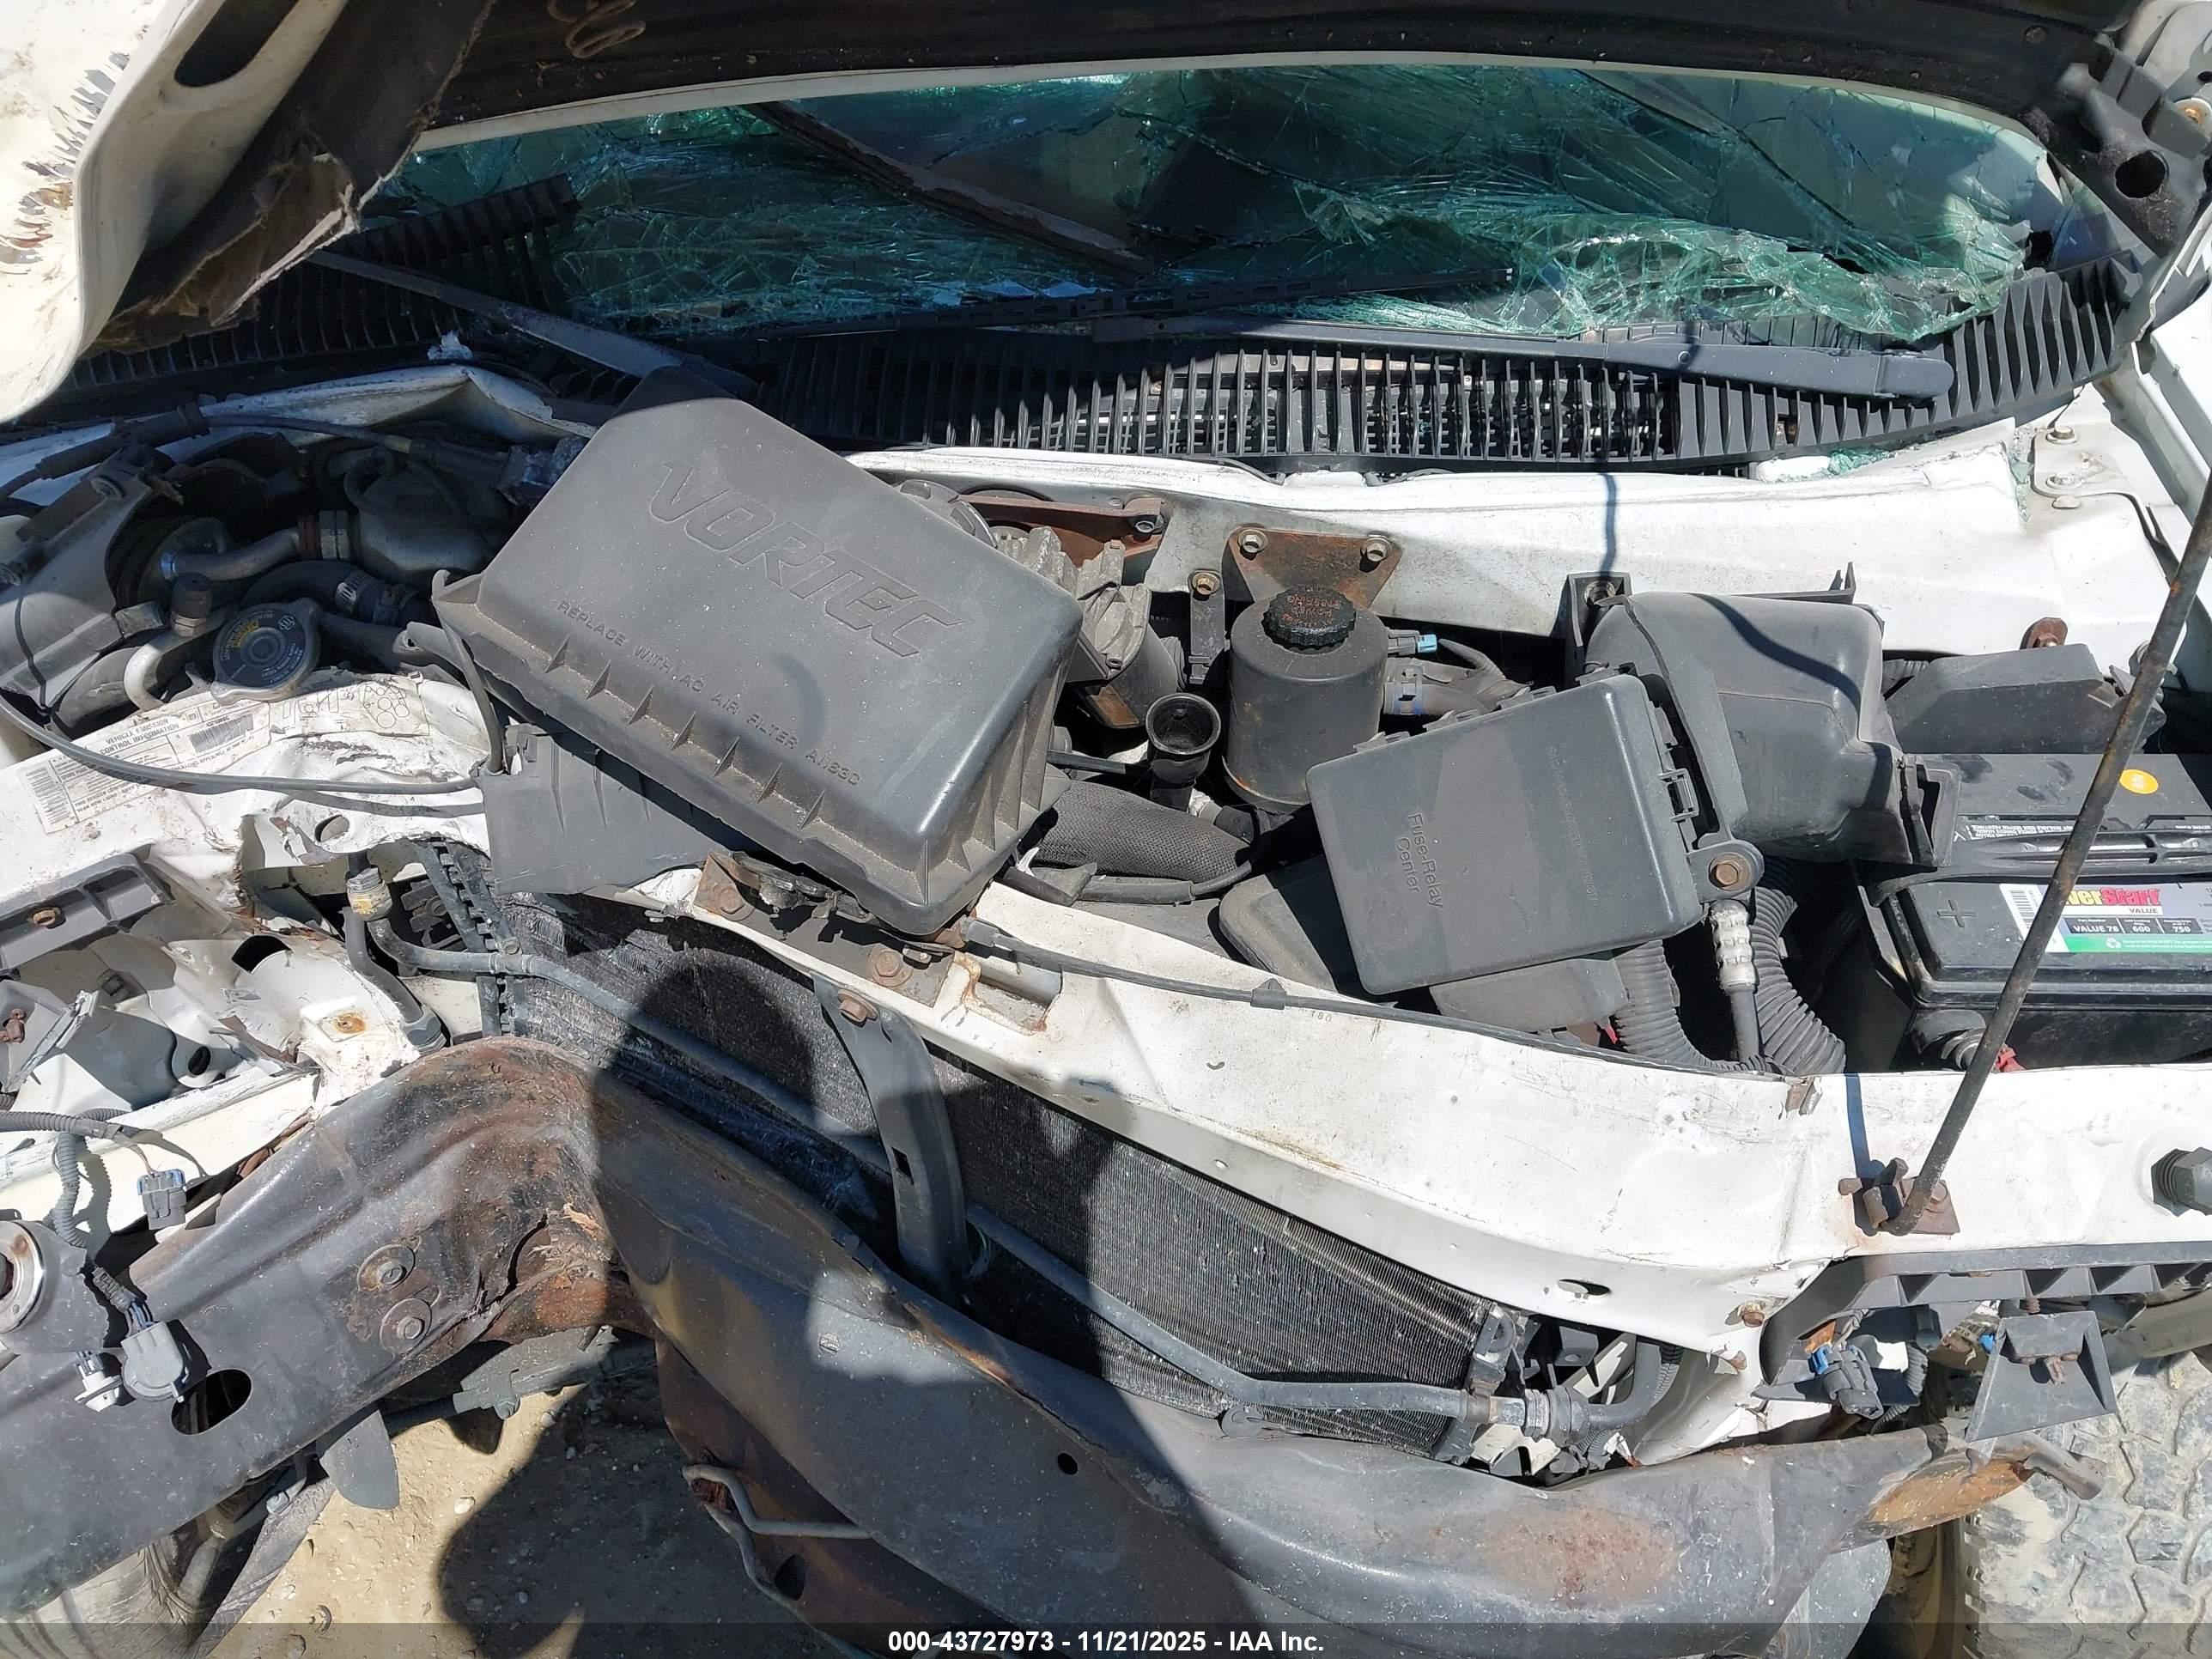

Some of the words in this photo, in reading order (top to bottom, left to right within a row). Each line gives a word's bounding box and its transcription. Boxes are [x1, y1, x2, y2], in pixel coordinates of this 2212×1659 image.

[649, 460, 964, 657] VORTEC
[556, 601, 627, 647] REPLACE
[633, 644, 674, 674] WITH
[678, 673, 705, 693] AC
[711, 690, 740, 715] AIR
[745, 713, 799, 750] FILTER
[100, 739, 133, 756] CONTROL
[133, 723, 179, 744] INFORMATION
[105, 729, 135, 744] VEHICLE
[136, 719, 169, 734] EMISSION
[1396, 837, 1421, 893] Center
[1408, 812, 1443, 908] Fuse-Relay
[2066, 886, 2161, 907] verStart
